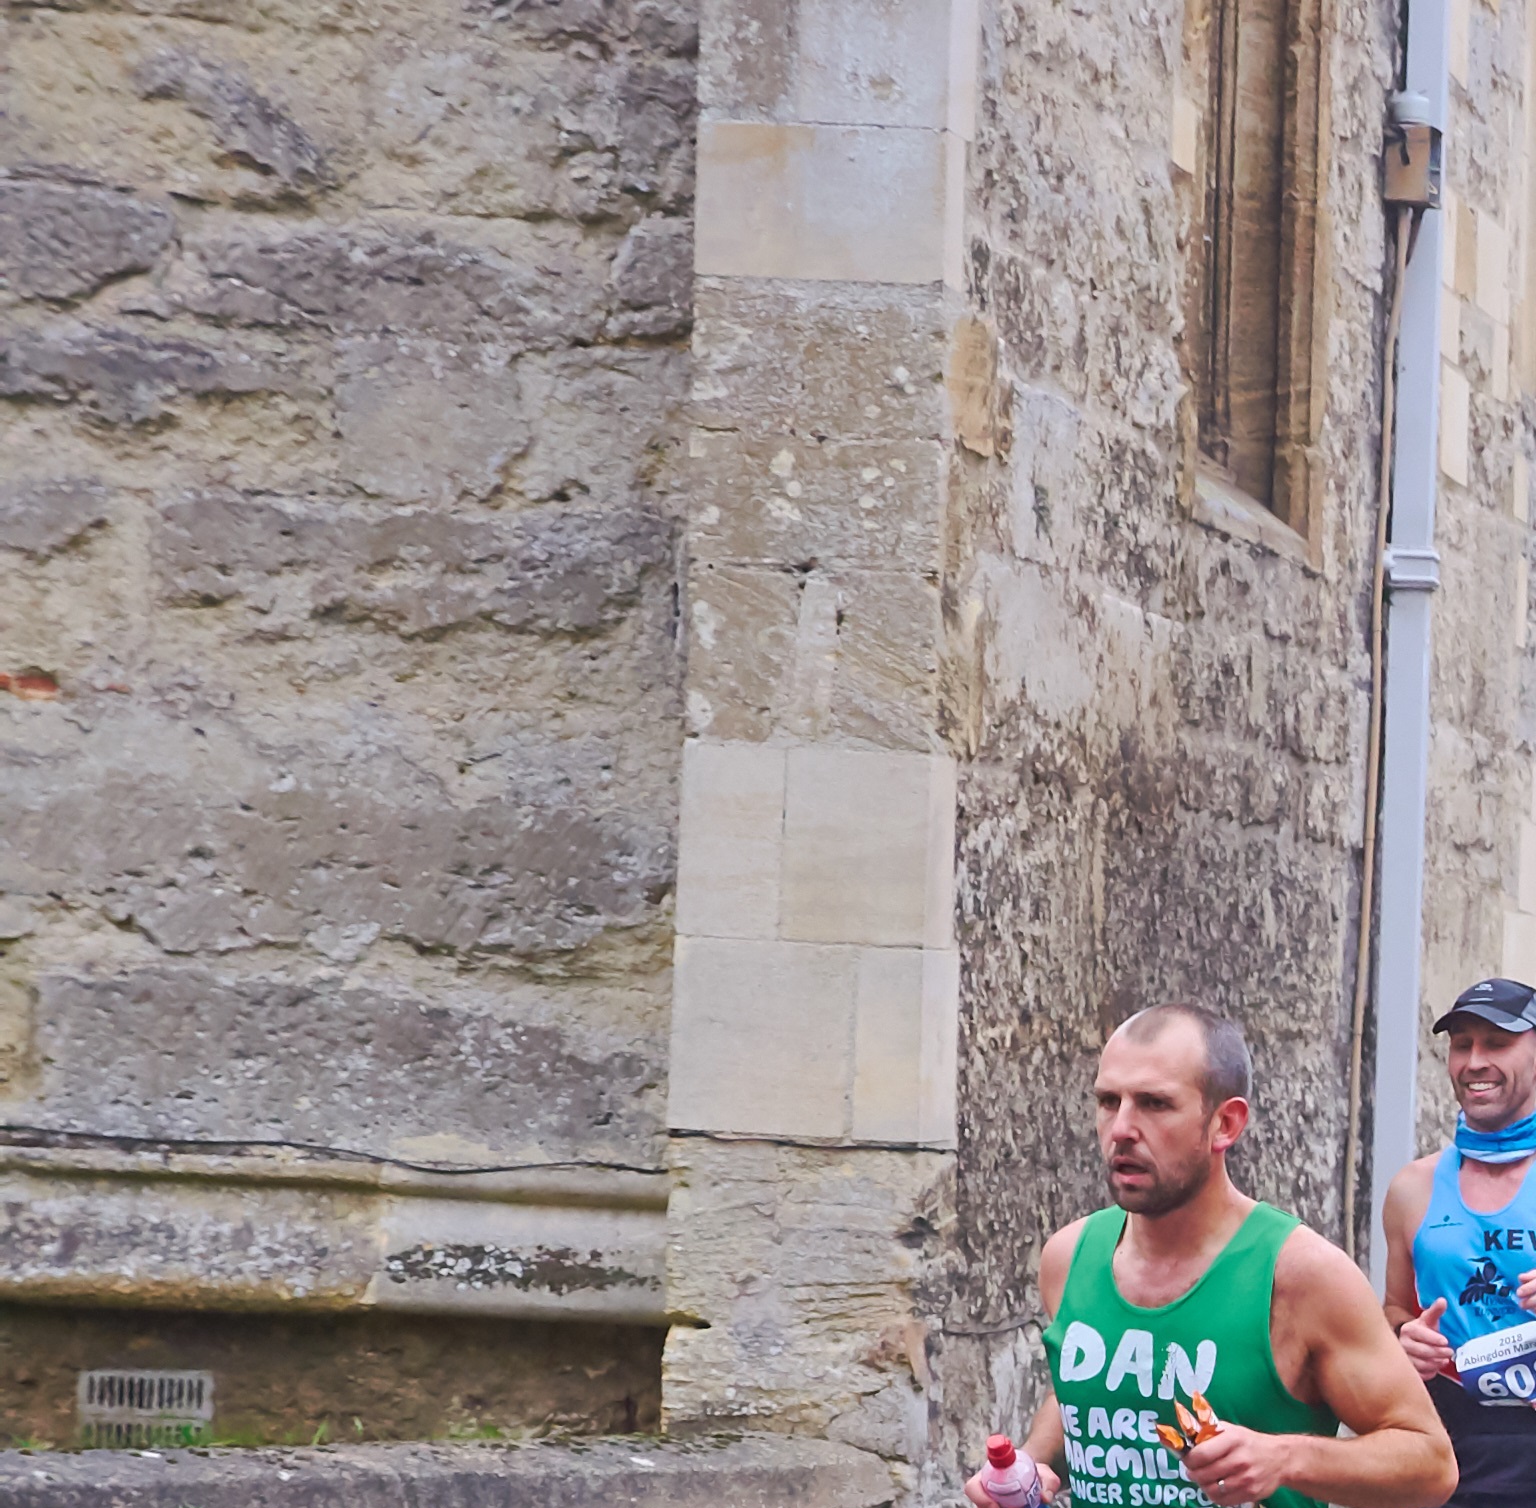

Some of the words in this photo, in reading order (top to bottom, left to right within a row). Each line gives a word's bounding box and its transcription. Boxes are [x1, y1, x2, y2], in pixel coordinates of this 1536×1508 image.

[1499, 1334, 1523, 1347] 2018
[1059, 1320, 1217, 1400] DAN
[1463, 1348, 1511, 1367] Abingdon
[1087, 1406, 1160, 1443] ARE
[1128, 1482, 1213, 1507] SUPPO
